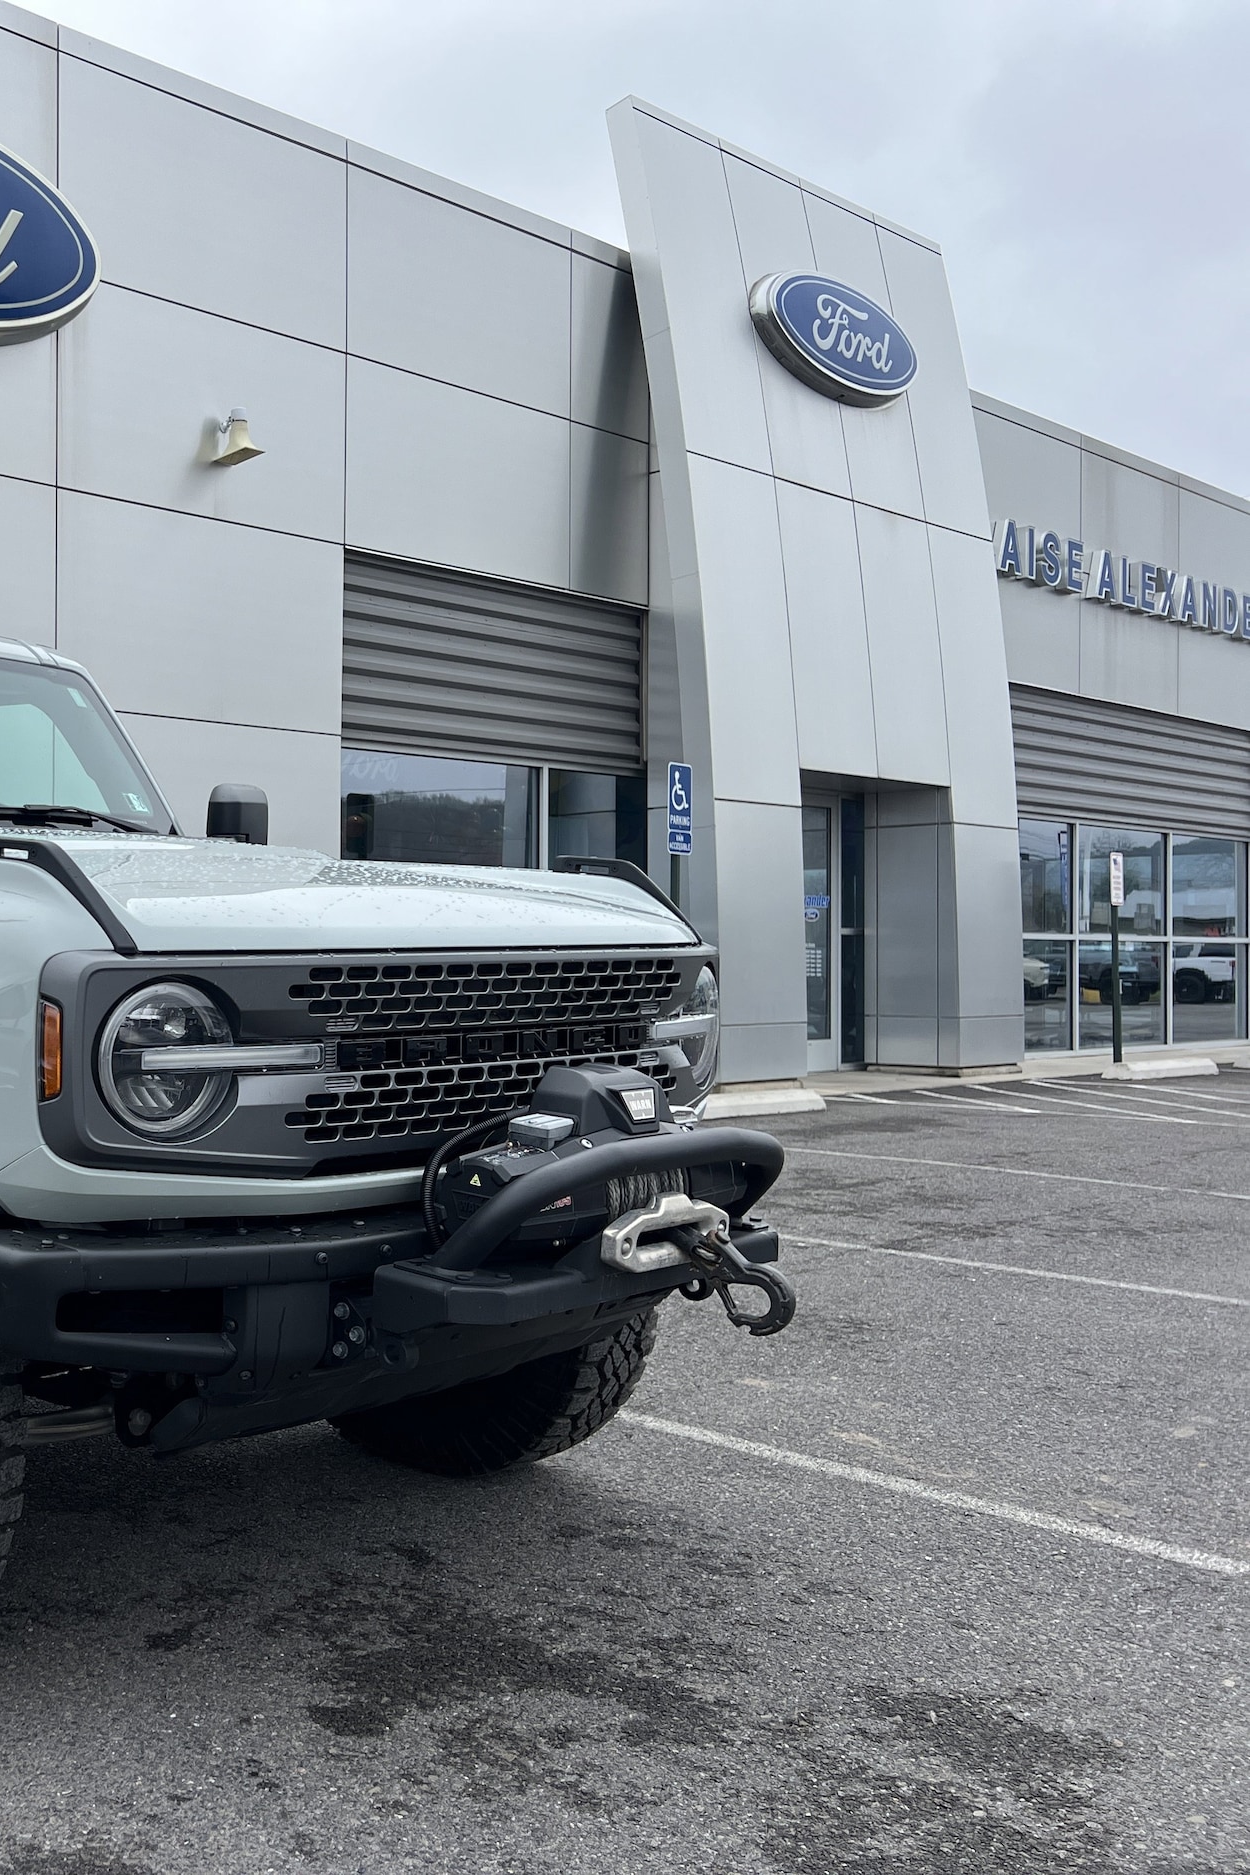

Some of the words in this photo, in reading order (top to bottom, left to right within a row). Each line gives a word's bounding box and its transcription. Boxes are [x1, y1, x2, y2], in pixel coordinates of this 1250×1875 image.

[812, 293, 893, 373] Ford
[996, 518, 1084, 593] AISE
[670, 814, 690, 827] PARKING
[805, 892, 830, 908] ander
[337, 1023, 648, 1067] BRONCO
[629, 1098, 653, 1111] WARN
